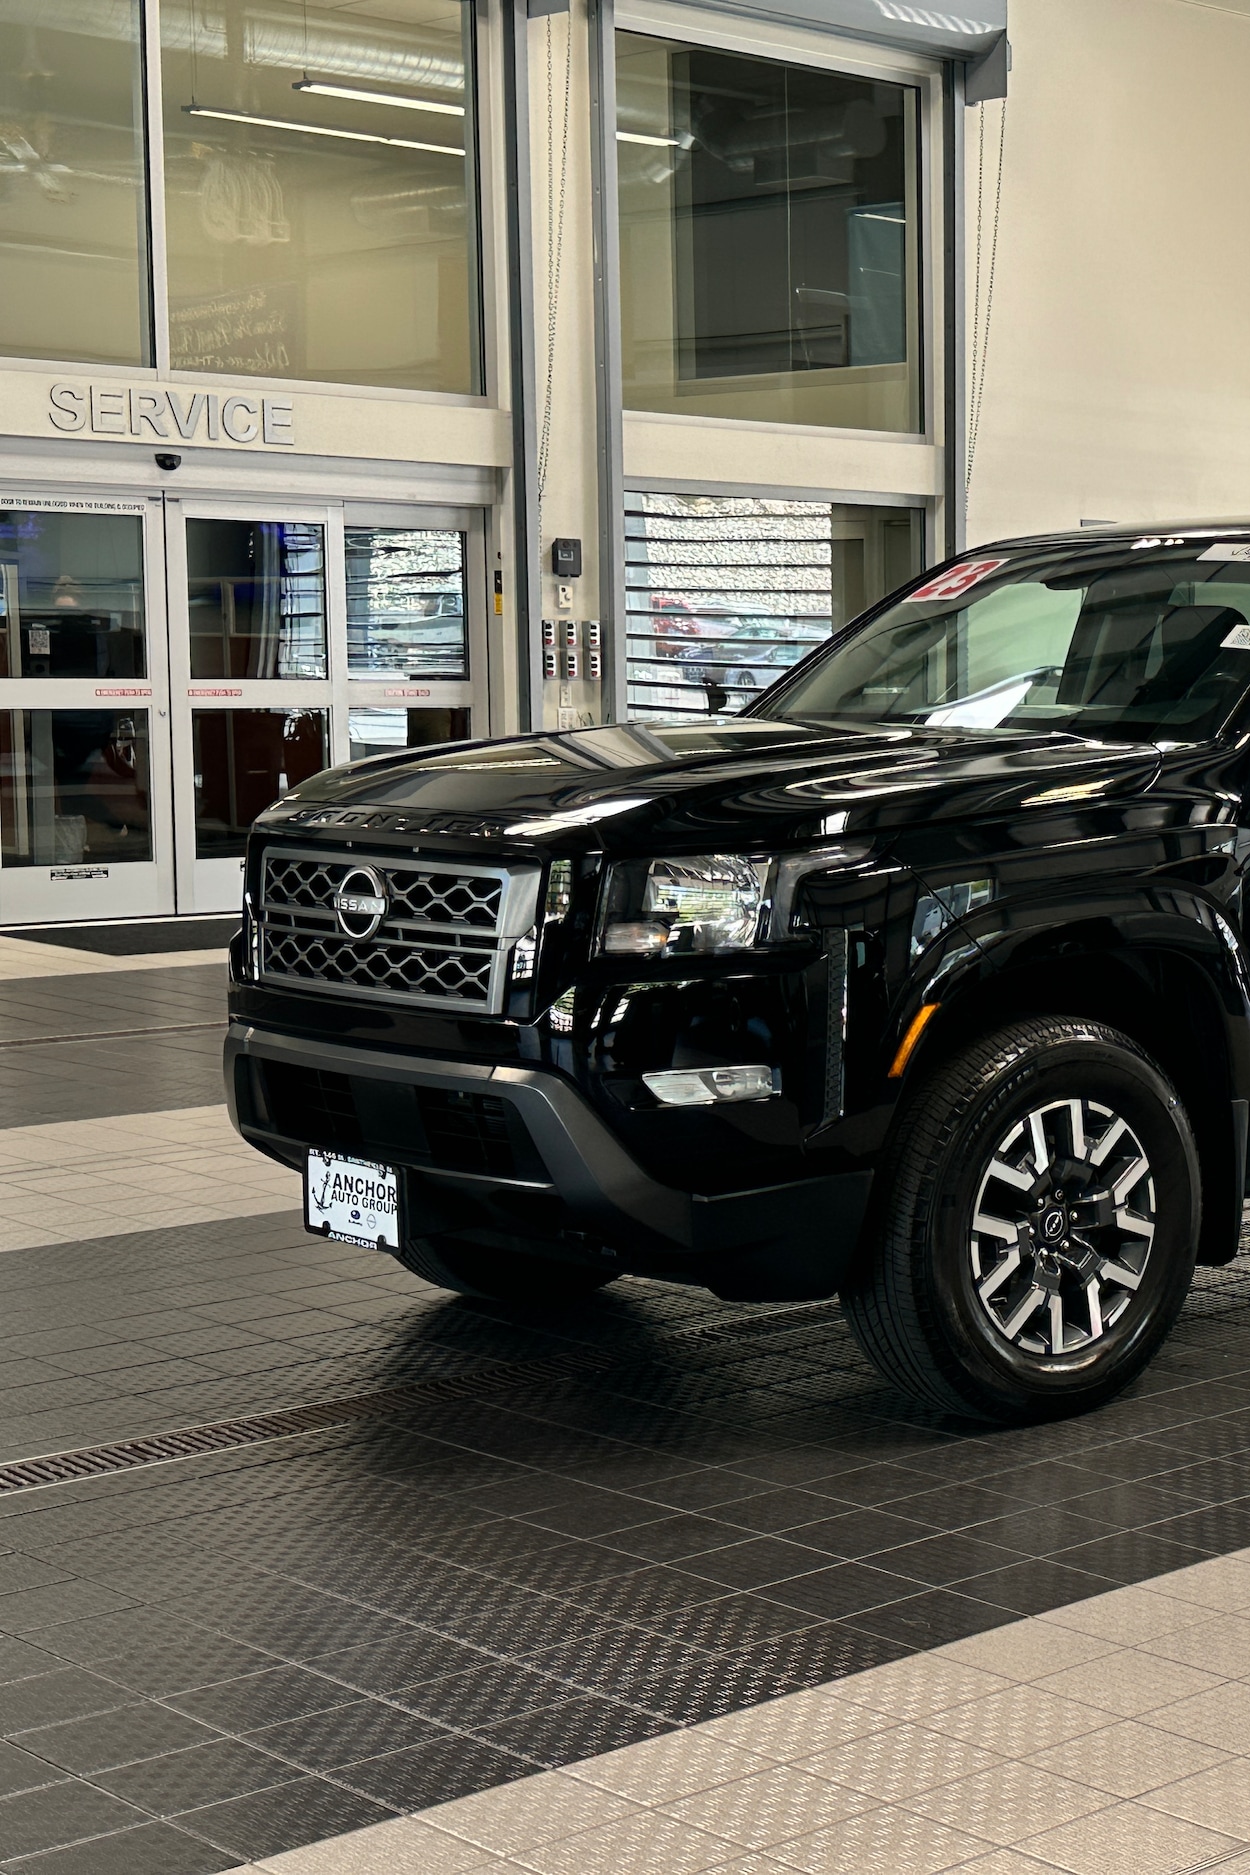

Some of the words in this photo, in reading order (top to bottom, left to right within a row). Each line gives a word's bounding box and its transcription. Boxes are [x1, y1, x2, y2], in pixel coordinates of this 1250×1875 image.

[48, 382, 296, 446] SERVICE
[332, 1172, 398, 1204] ANCHOR
[331, 1190, 359, 1206] AUTO
[361, 1197, 398, 1215] GROUP
[328, 1231, 378, 1250] ANCHOR
